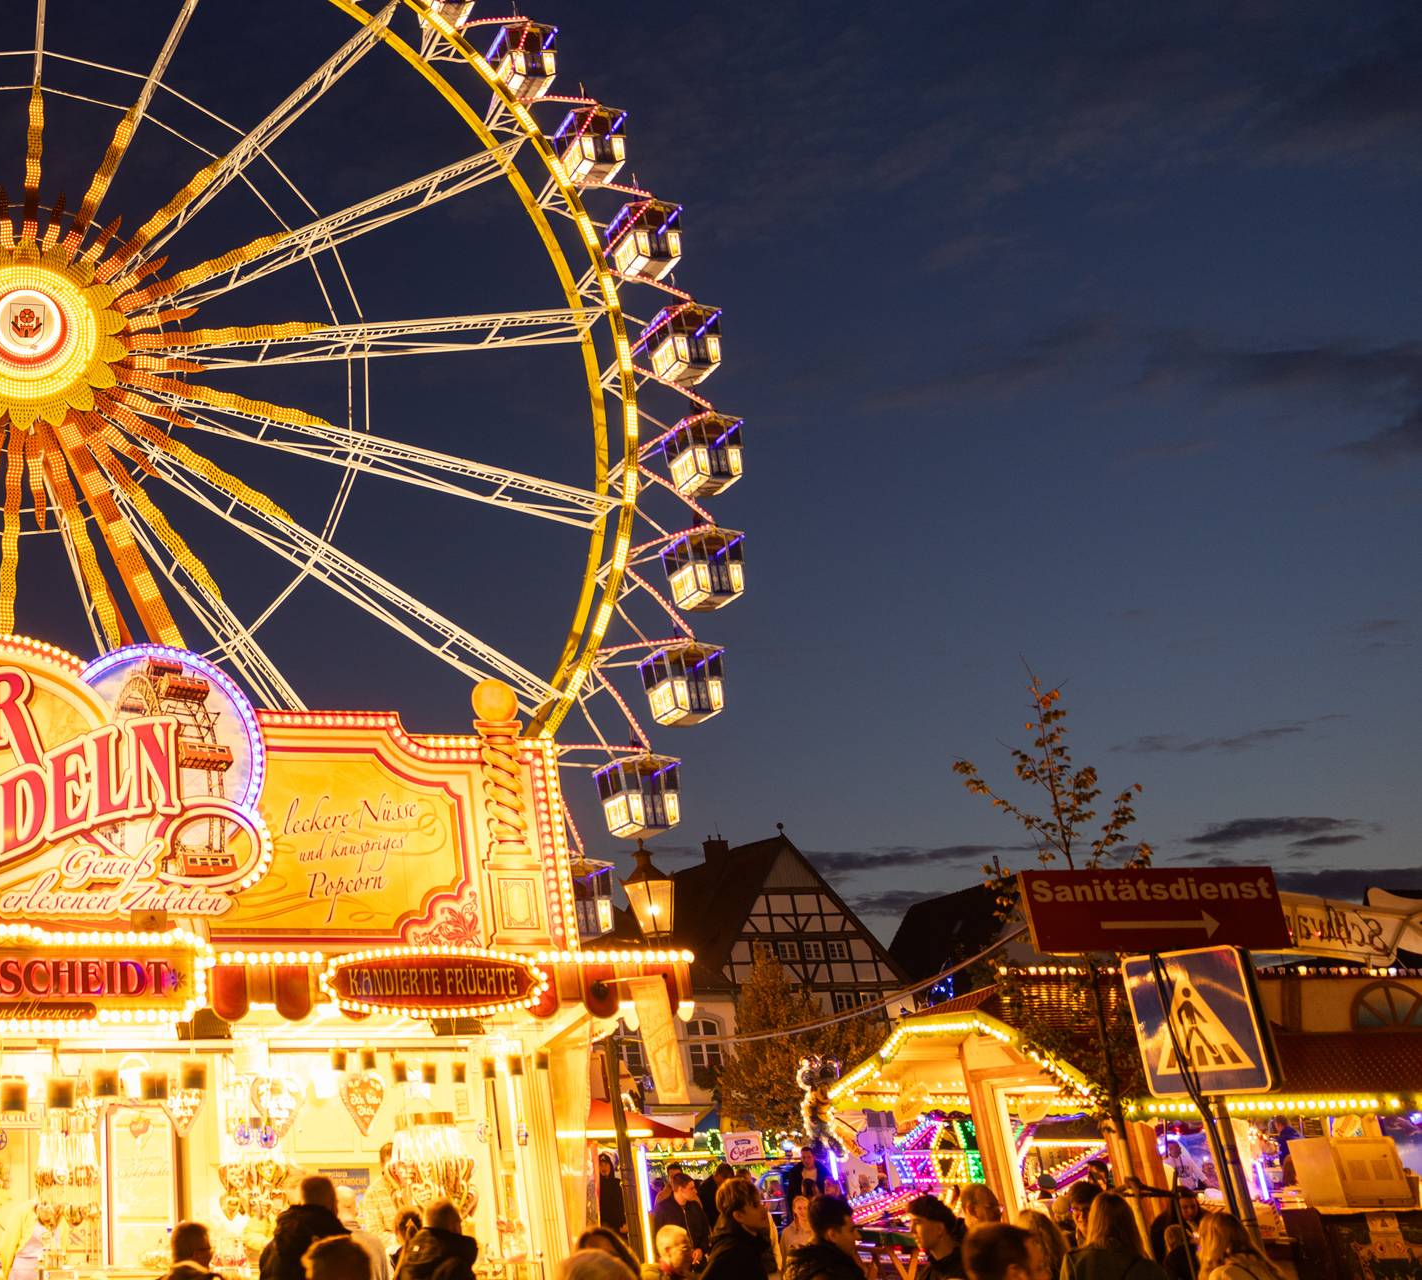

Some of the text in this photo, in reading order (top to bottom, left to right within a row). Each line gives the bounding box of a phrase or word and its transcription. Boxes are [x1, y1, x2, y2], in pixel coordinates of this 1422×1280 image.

[283, 793, 419, 836] leckere Nüsse
[65, 843, 154, 890] Genuß
[298, 830, 408, 873] und knuspriges
[2, 873, 112, 911] erlesenen
[123, 884, 226, 912] Zutaten
[308, 871, 387, 923] Popcorn
[1030, 876, 1273, 903] Sanitätsdienst
[347, 965, 519, 997] KANDIERTE FRÜCHTE
